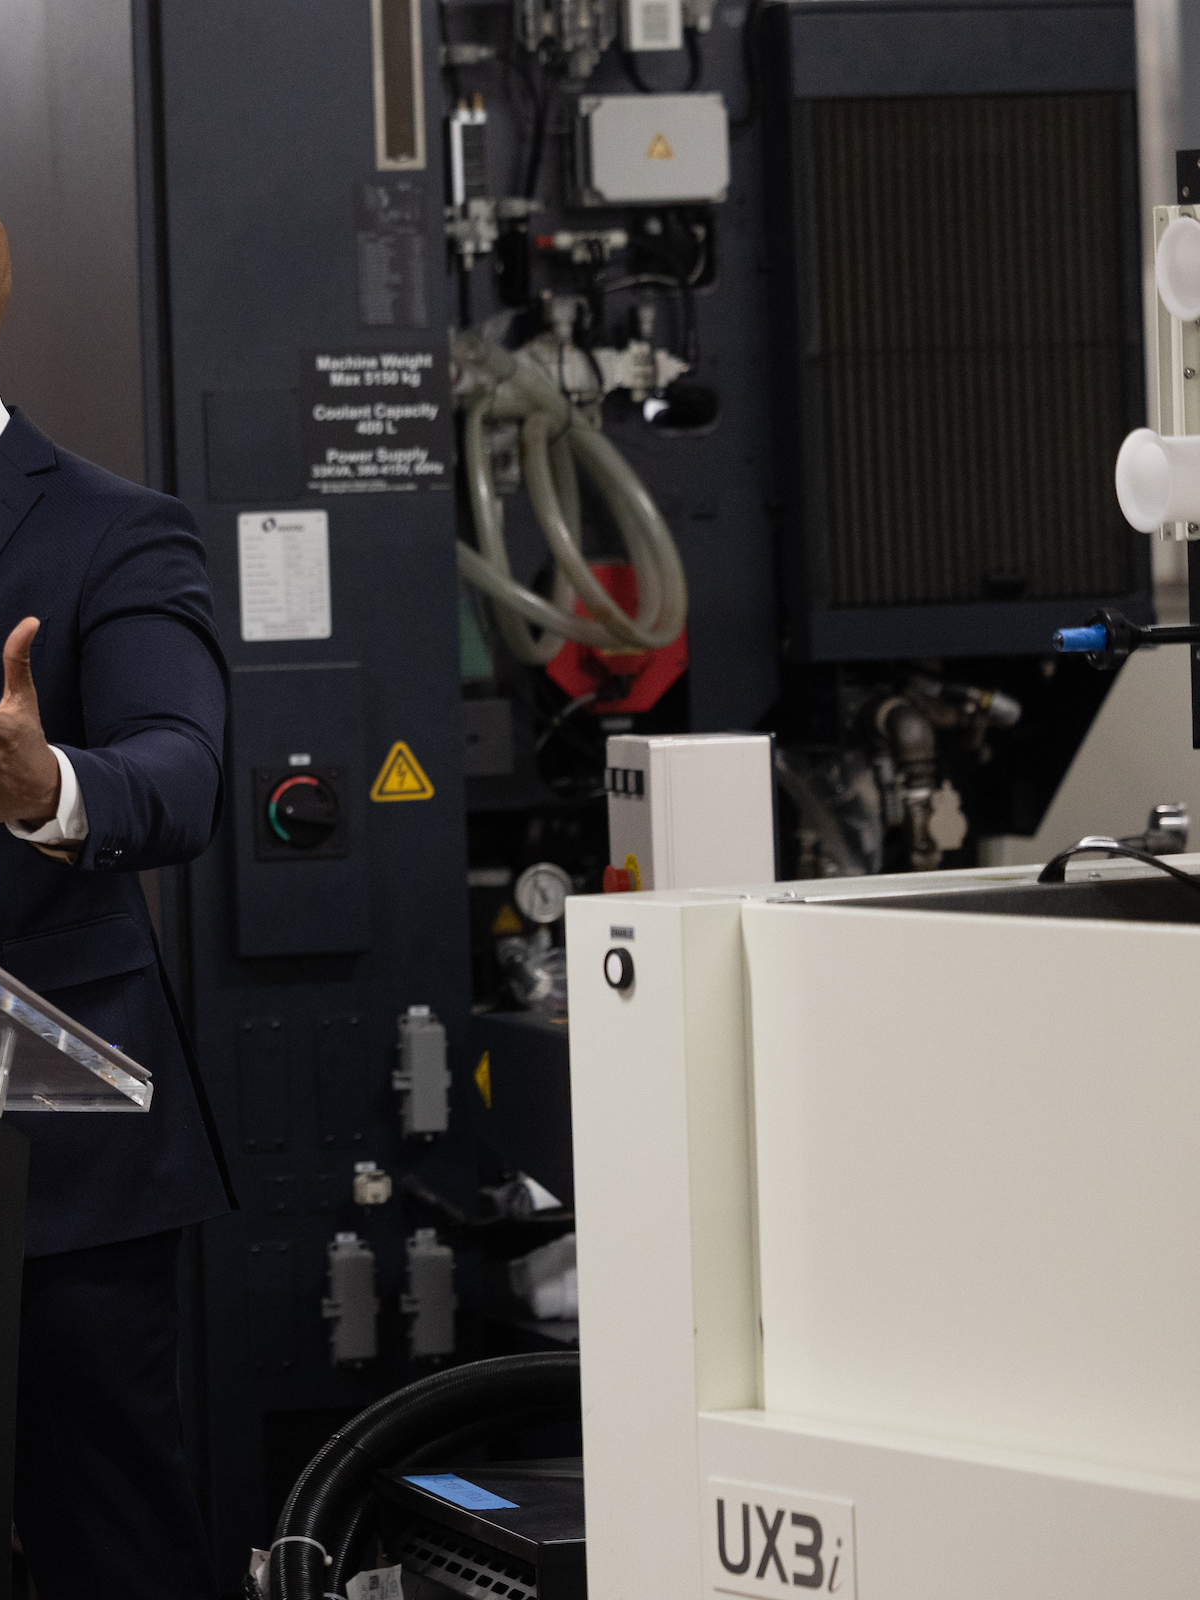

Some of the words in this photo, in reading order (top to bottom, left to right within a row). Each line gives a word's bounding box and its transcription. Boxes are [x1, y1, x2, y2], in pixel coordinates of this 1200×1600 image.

[315, 354, 378, 371] Machine
[379, 353, 433, 371] Weight
[329, 371, 361, 387] Max
[363, 370, 399, 386] 5150
[401, 370, 421, 388] kg
[312, 403, 372, 421] Coolant
[373, 402, 439, 421] Capacity
[385, 420, 398, 435] L
[326, 447, 374, 464] Power
[375, 445, 429, 465] Supply
[716, 1497, 843, 1594] UX3i
